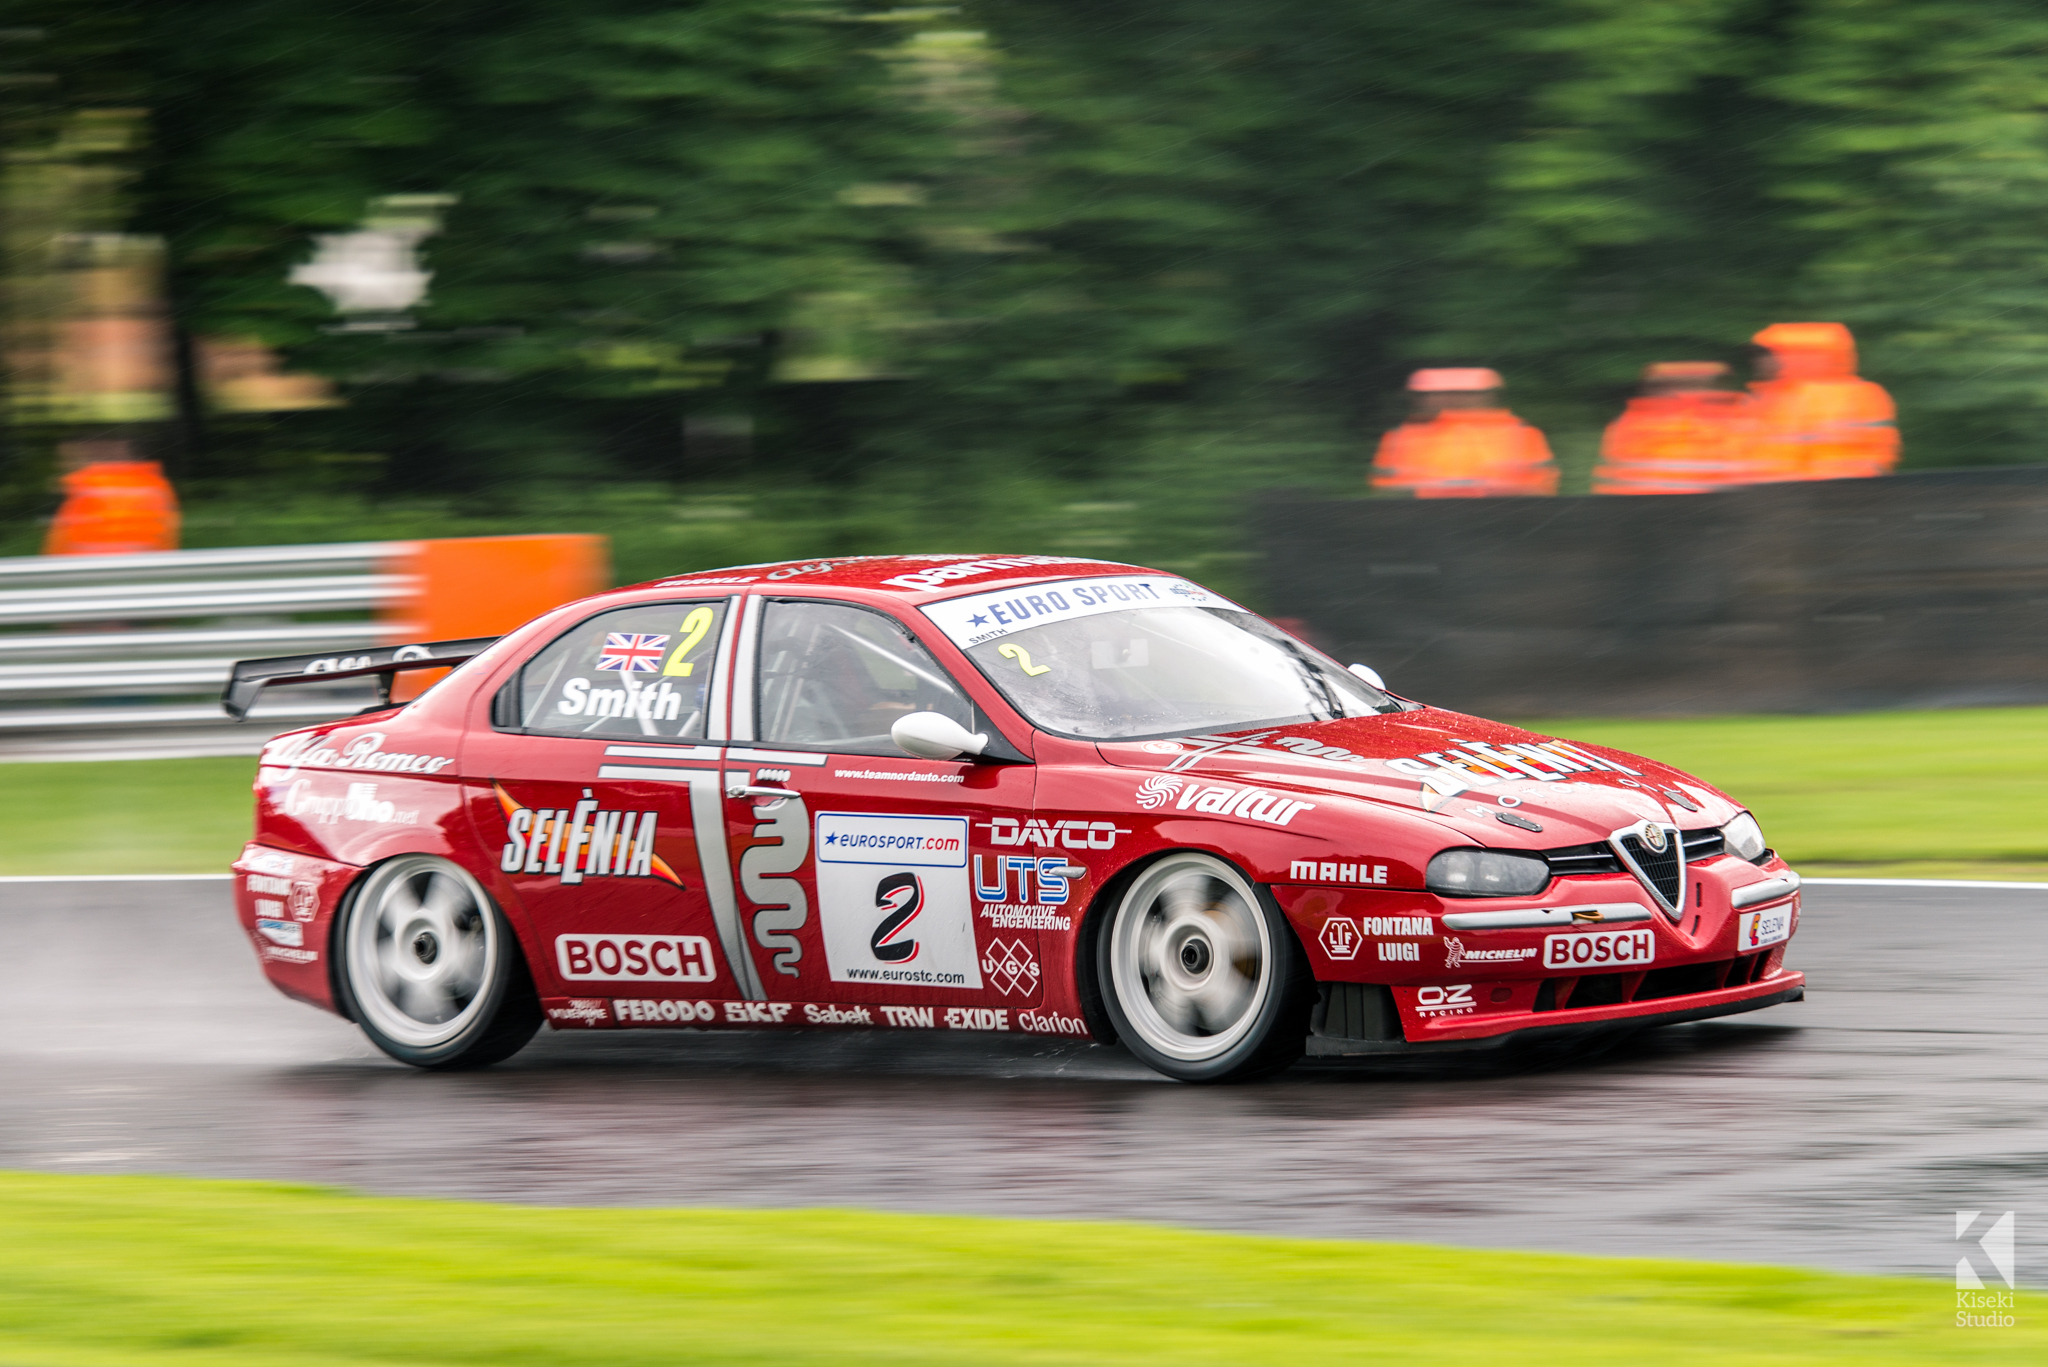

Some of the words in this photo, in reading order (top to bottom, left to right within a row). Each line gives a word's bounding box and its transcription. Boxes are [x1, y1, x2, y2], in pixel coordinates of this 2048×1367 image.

[988, 591, 1070, 625] EURO
[1077, 583, 1160, 606] SPORT
[662, 606, 714, 677] 2
[969, 628, 1008, 644] SMITH
[998, 643, 1051, 677] 2
[557, 677, 682, 720] Smith
[335, 732, 455, 774] Romeo
[834, 769, 965, 783] www.teamnordauto.com
[991, 817, 1116, 850] DAYCO
[974, 854, 1069, 904] UTS
[1290, 860, 1388, 885] MAHLE
[871, 872, 924, 963] 2
[980, 904, 1057, 918] AUTOMOTIVE
[992, 915, 1071, 931] ENGENEERING
[1363, 917, 1434, 935] FONTANA
[565, 939, 709, 977] BOSCH
[1378, 942, 1420, 961] LUIGI
[1464, 948, 1538, 960] MICHELIN
[1550, 933, 1650, 966] BOSCH
[847, 967, 965, 984] www.eurostc.com
[613, 1000, 716, 1022] FERODO
[724, 1002, 793, 1022] SKF
[803, 1004, 874, 1025] Sabelt
[880, 1006, 935, 1028] TRW
[944, 1008, 1010, 1031] EXIDE
[1419, 1007, 1474, 1018] RACING
[1018, 1011, 1089, 1035] Clarion
